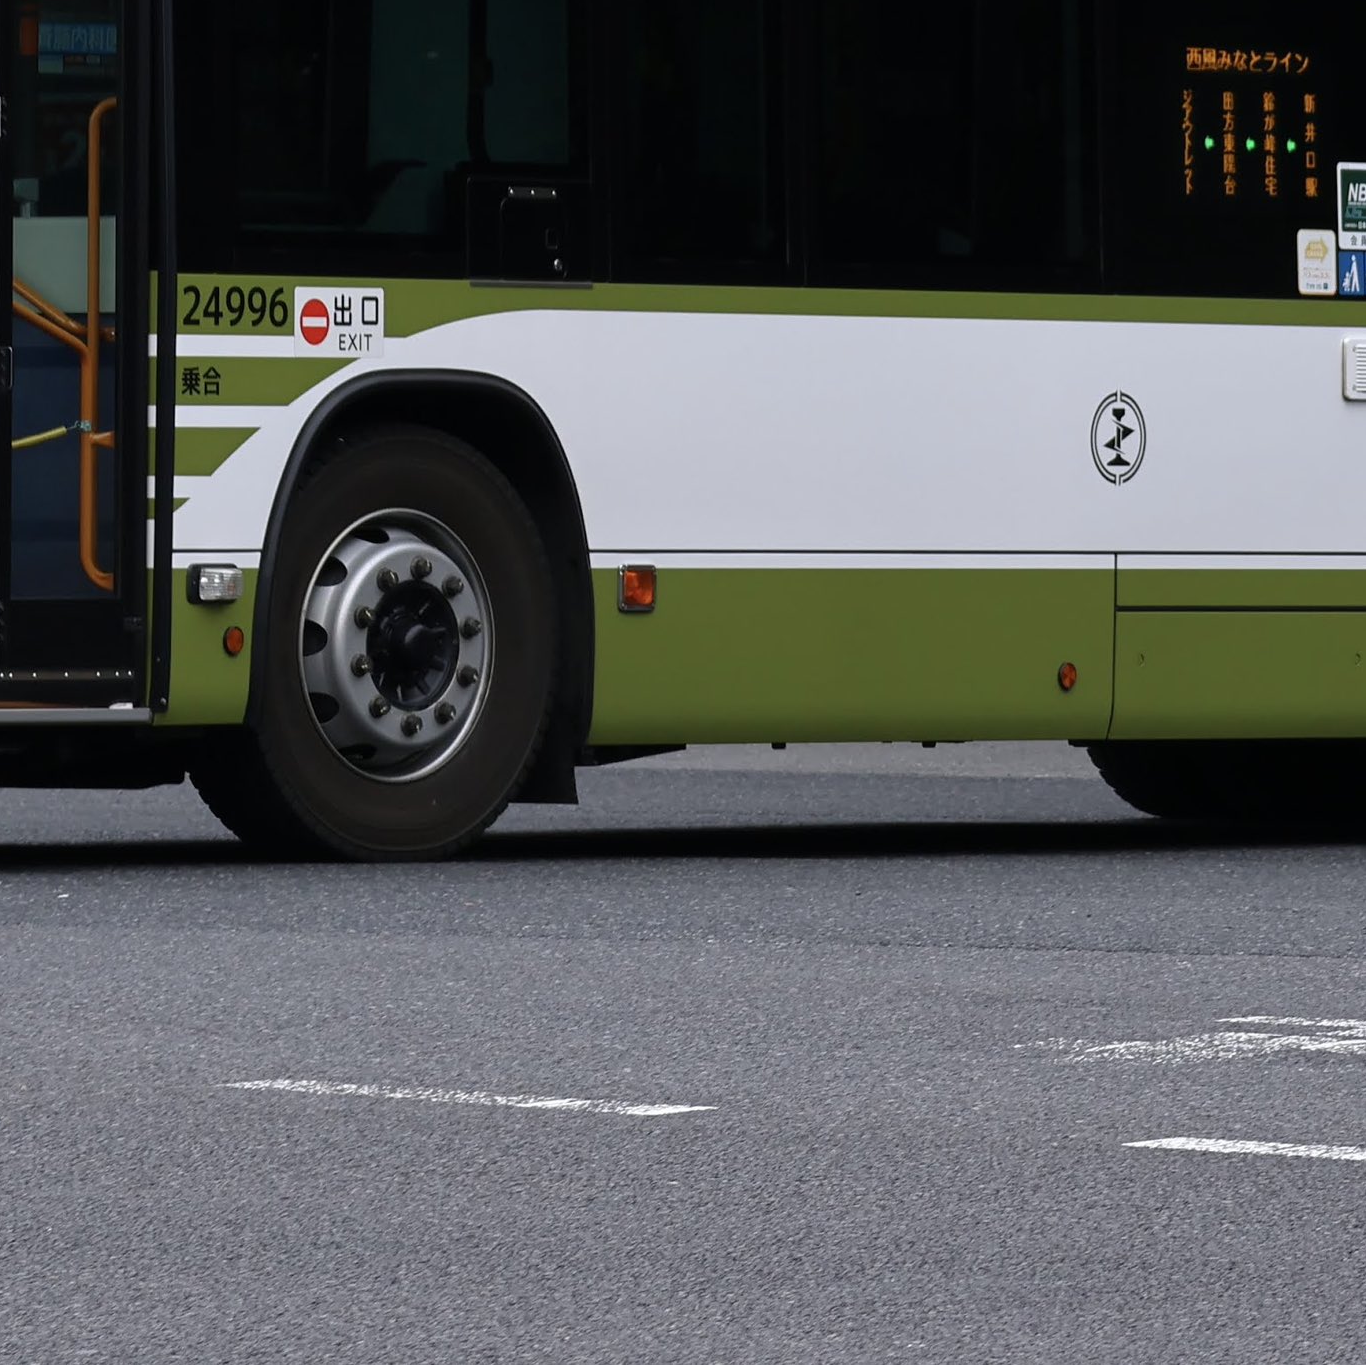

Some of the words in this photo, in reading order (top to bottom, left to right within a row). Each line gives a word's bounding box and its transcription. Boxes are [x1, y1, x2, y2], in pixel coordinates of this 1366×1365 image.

[183, 286, 288, 327] 24996
[334, 294, 379, 326] 出口
[339, 334, 372, 351] EXIT
[182, 367, 221, 396] 乗合
